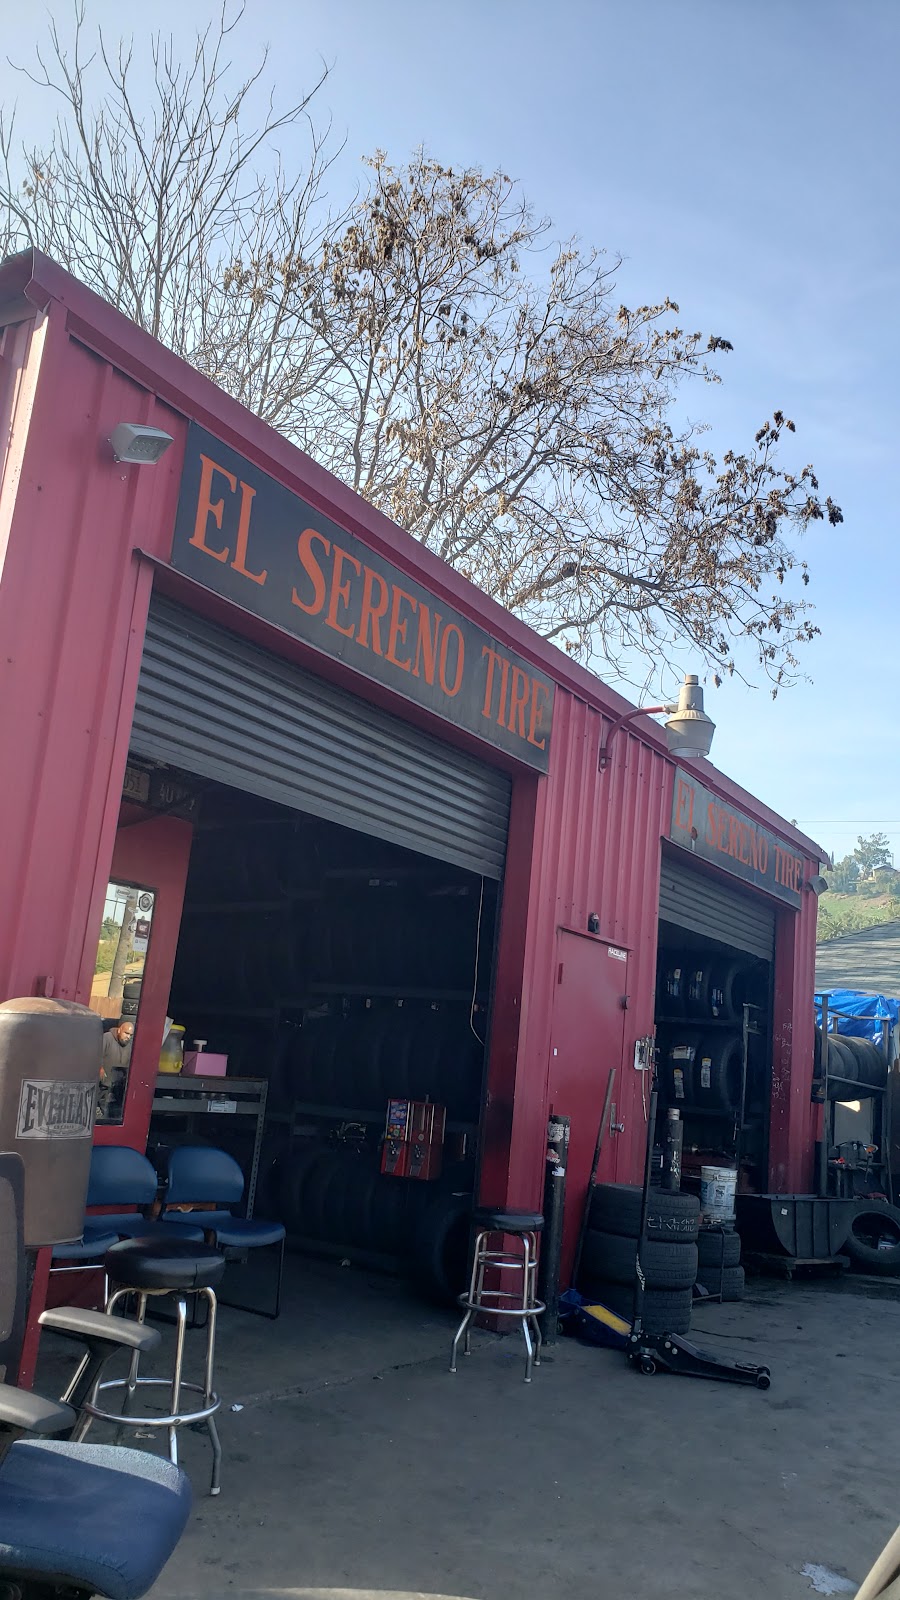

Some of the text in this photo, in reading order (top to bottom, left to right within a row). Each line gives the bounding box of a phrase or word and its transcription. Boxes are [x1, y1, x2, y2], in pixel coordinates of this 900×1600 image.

[189, 453, 549, 751] EL SERENO TIRE
[674, 778, 802, 895] EL SERENO TIRE
[22, 1083, 96, 1134] EVERLAST
